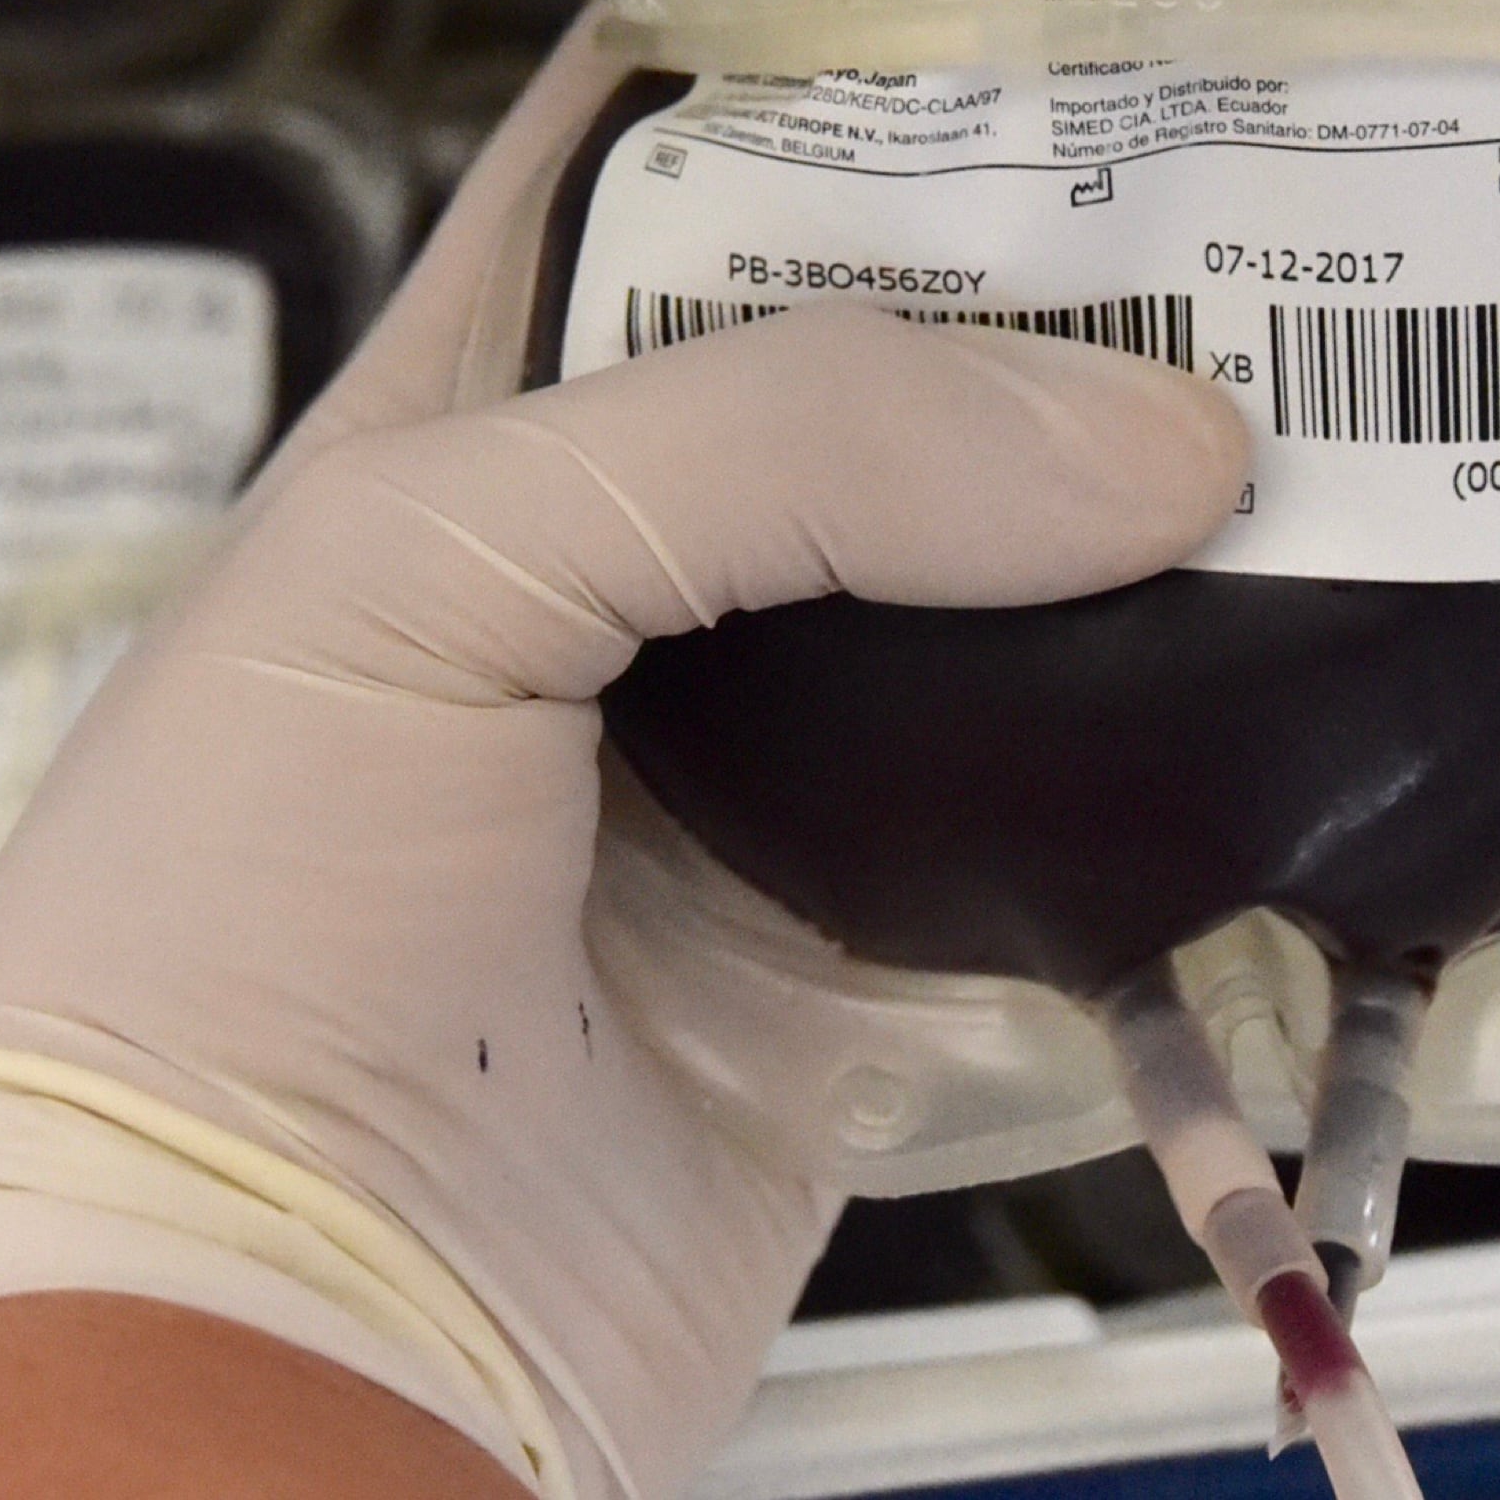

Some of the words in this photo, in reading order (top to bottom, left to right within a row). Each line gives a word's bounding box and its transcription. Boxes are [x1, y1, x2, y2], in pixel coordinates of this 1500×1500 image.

[864, 72, 916, 90] Japan
[1049, 60, 1144, 76] Certificado
[1050, 95, 1139, 116] Importado
[1159, 76, 1251, 100] Distribuido
[1256, 79, 1288, 97] por:
[778, 112, 842, 138] EUROPE
[848, 128, 884, 145] N.V.,
[888, 127, 968, 146] Ikaroslaan
[1052, 119, 1113, 136] SIMED
[1119, 115, 1154, 132] CIA.
[1217, 97, 1287, 116] Ecuador
[782, 140, 854, 163] BELGIUM
[1052, 140, 1123, 158] Número
[1155, 121, 1227, 142] Registro
[1232, 118, 1314, 139] Sanitario:
[1317, 118, 1460, 141] DM-0771-07-04
[1204, 242, 1404, 283] 07-12-2017
[1210, 352, 1253, 384] XB
